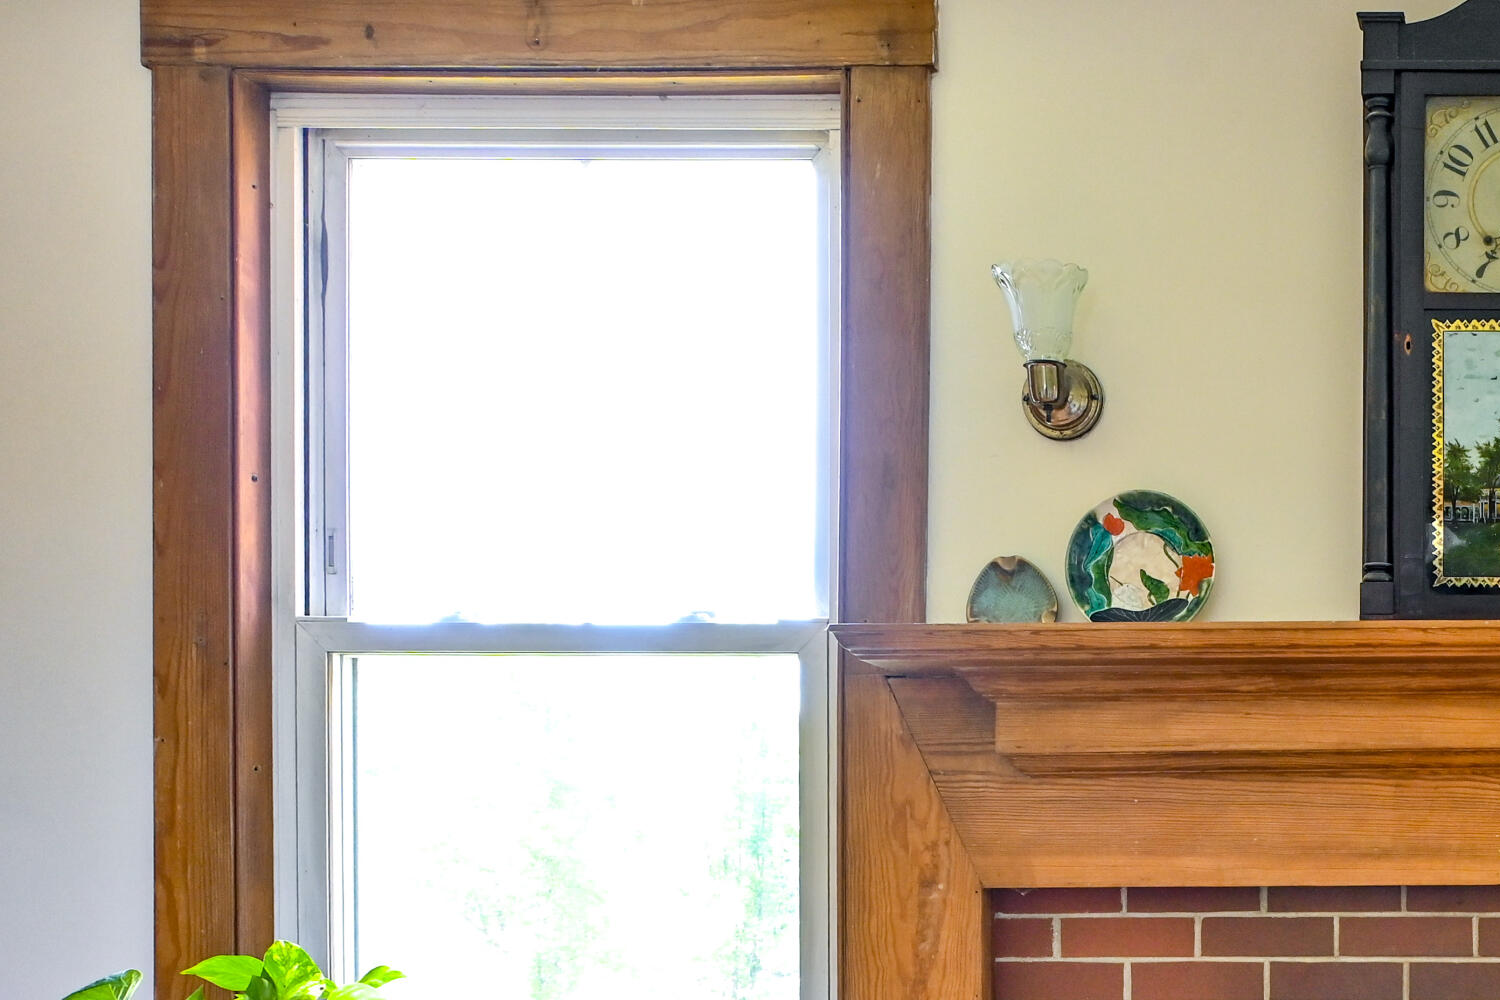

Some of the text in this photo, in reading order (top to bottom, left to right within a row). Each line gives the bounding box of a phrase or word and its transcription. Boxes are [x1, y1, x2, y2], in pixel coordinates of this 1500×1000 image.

[1442, 144, 1474, 180] 10
[1432, 189, 1460, 209] 9
[1442, 226, 1470, 250] 8
[1475, 250, 1500, 279] 7
